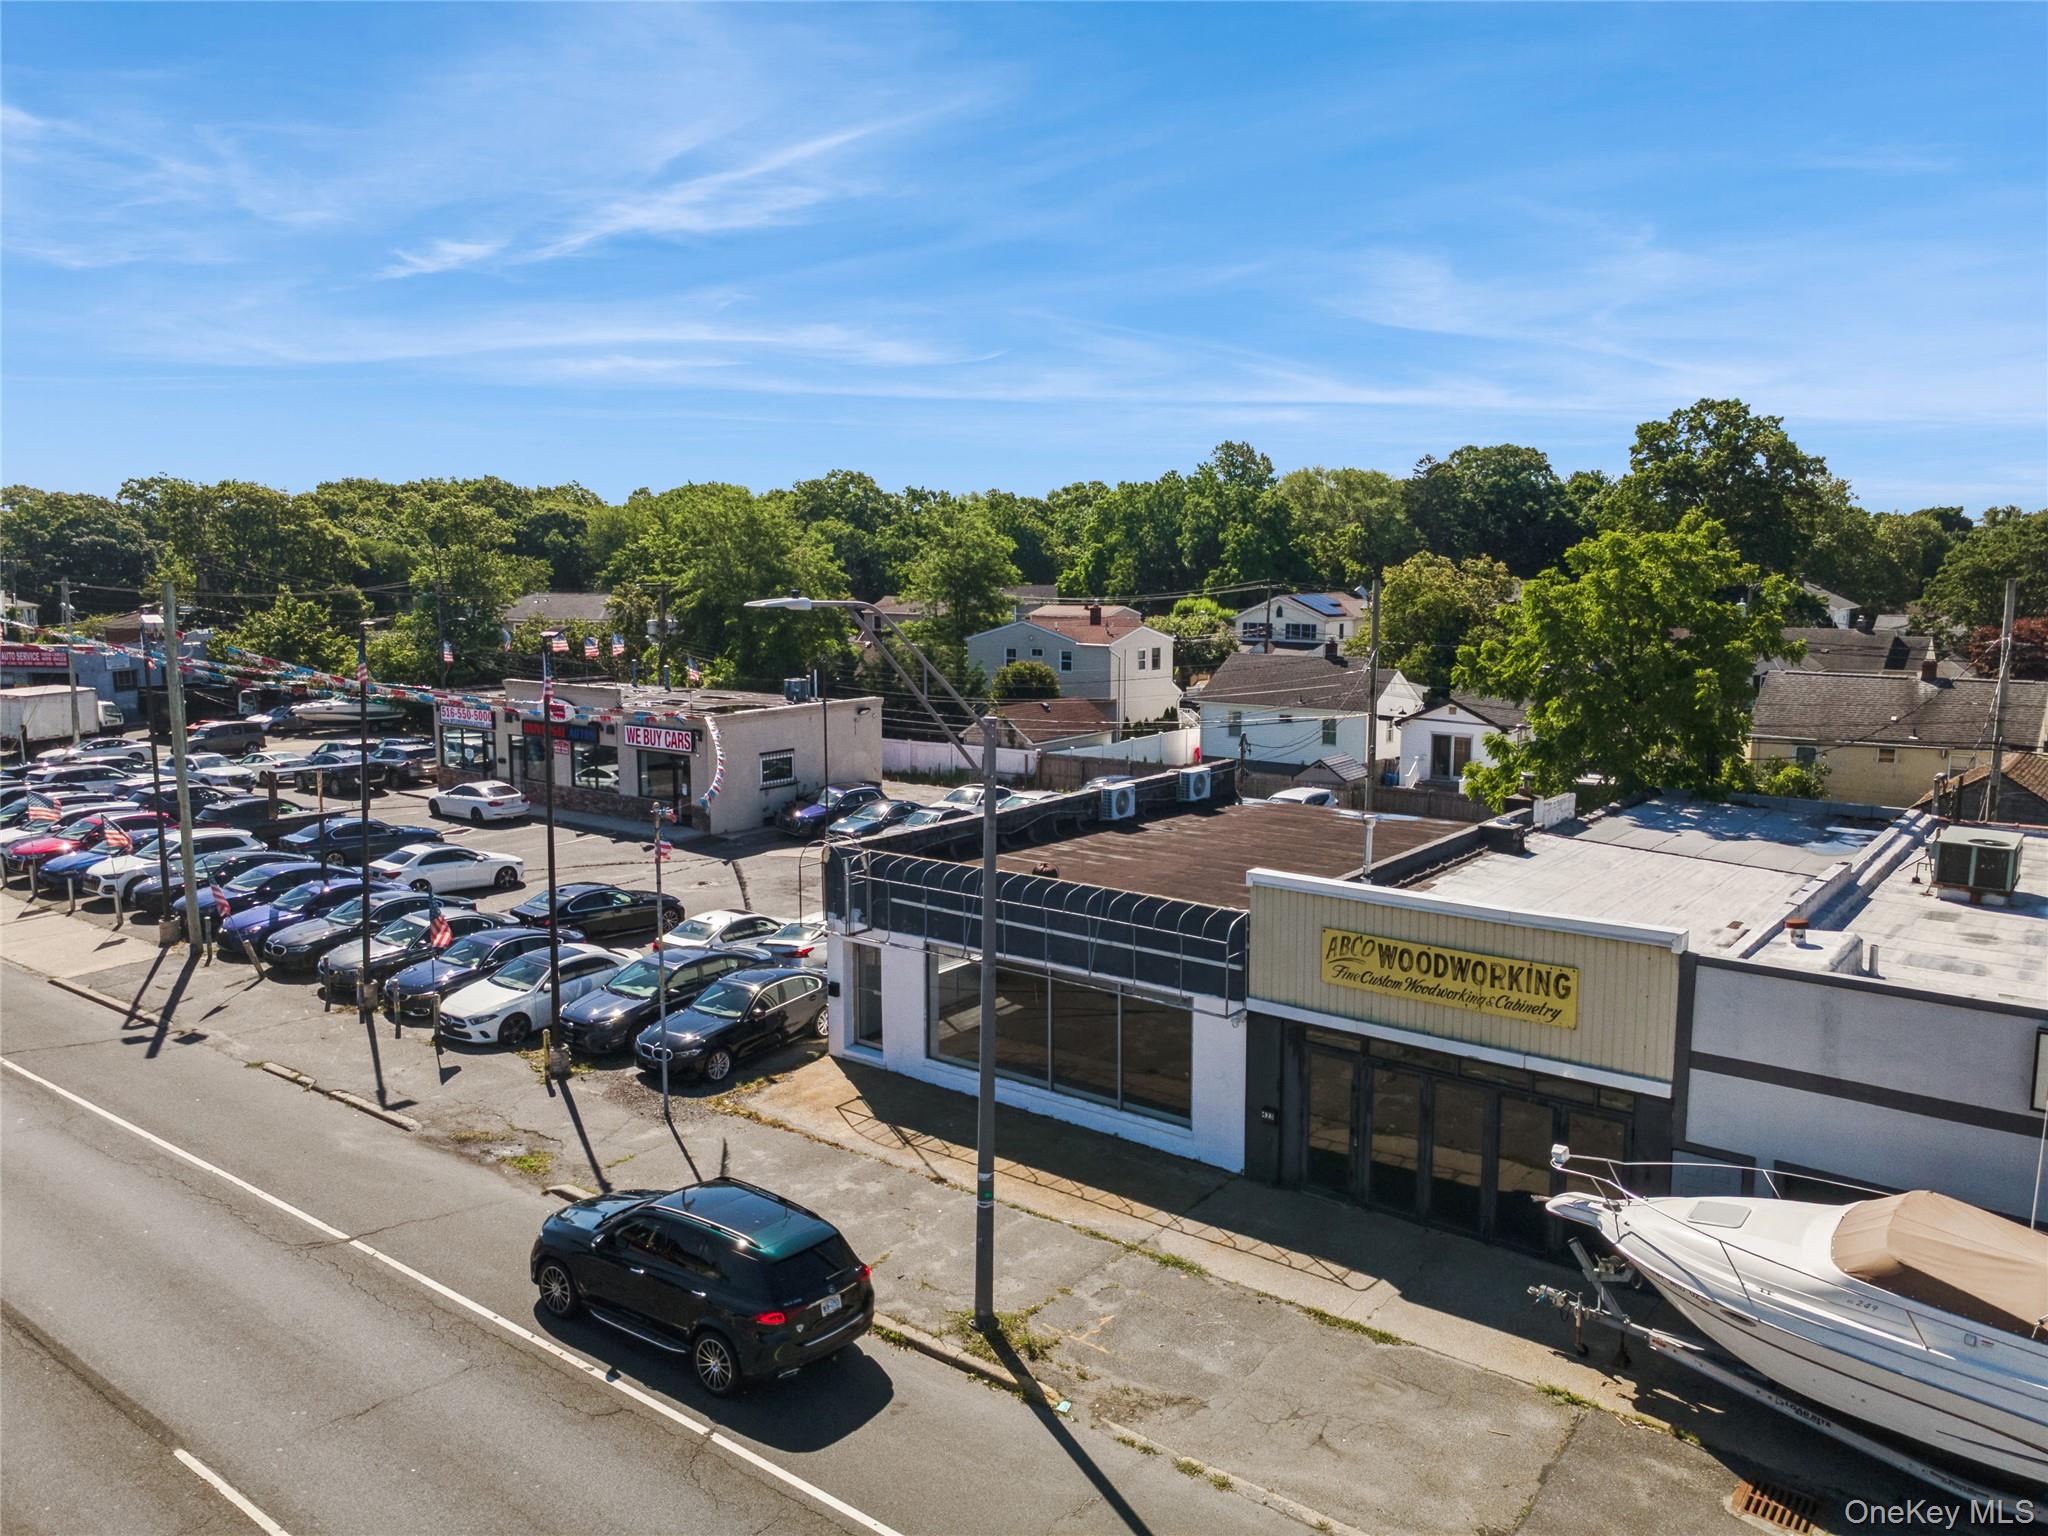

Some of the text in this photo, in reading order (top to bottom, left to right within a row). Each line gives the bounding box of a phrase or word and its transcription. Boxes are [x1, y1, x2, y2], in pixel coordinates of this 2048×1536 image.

[16, 652, 40, 661] SERVICE
[626, 727, 691, 750] WE BUY CARS
[1326, 935, 1572, 999] ABCO WOODWORKING
[1331, 964, 1360, 982] Fine
[1360, 971, 1402, 991] Custom
[1401, 977, 1486, 1007] Woodworking
[1495, 995, 1562, 1022] Cabinetry
